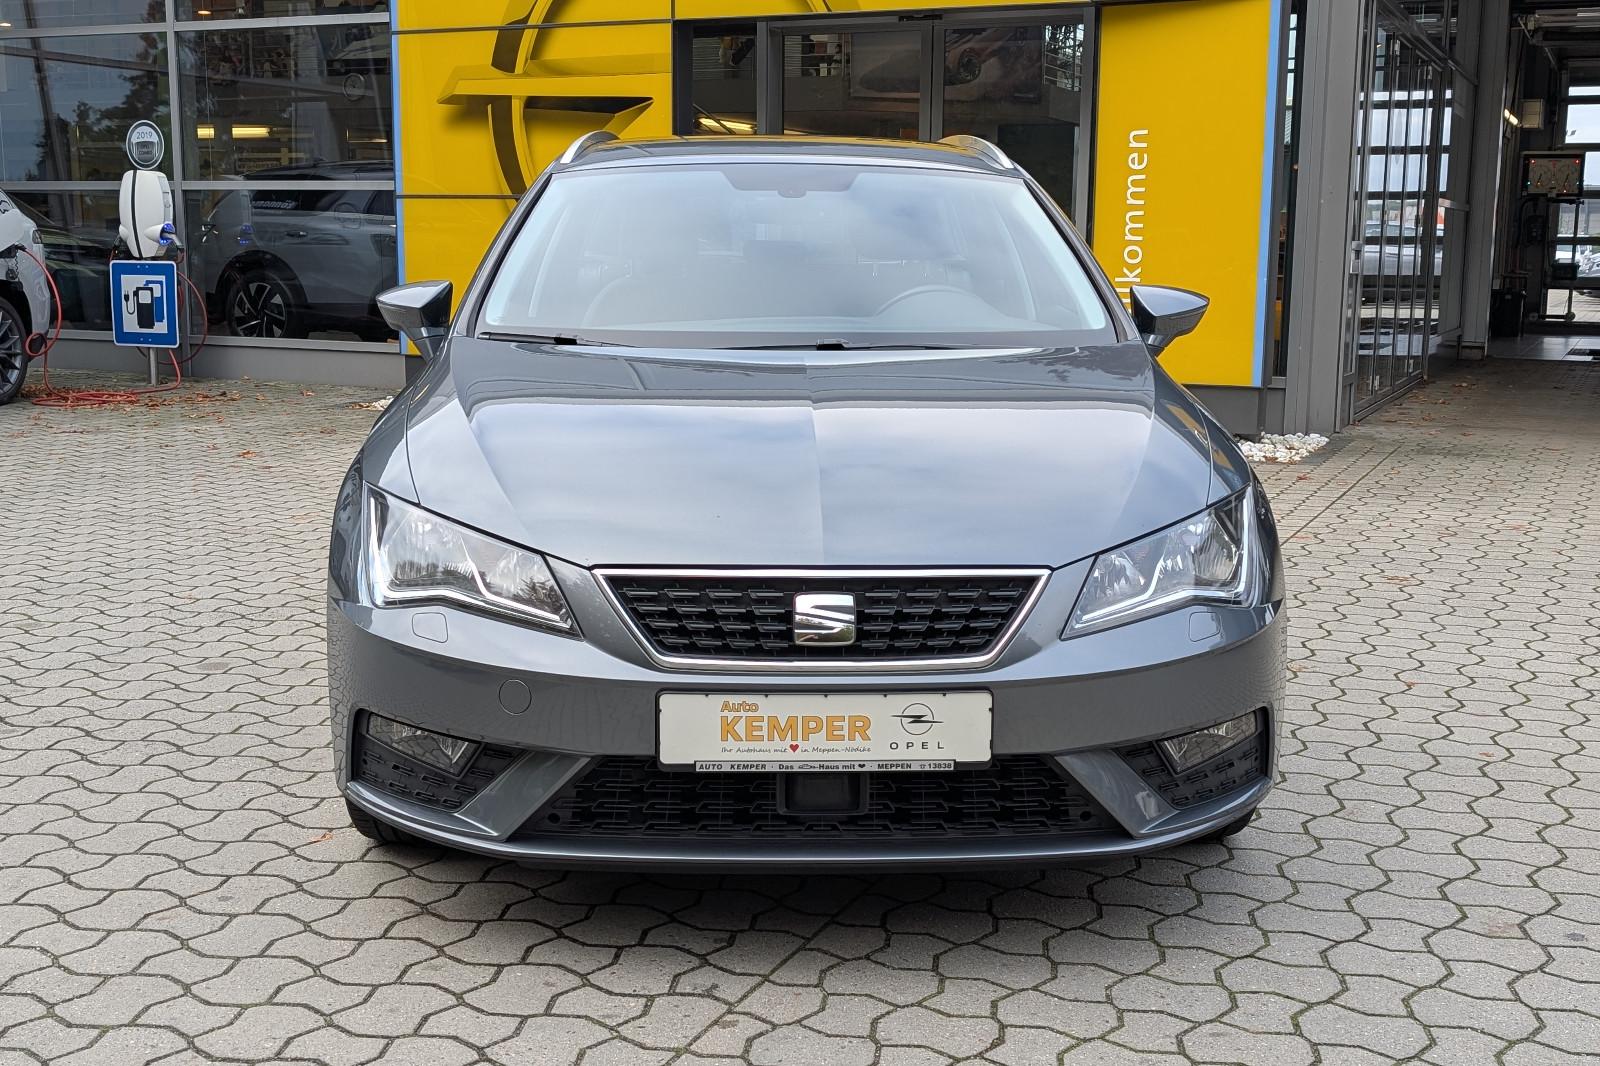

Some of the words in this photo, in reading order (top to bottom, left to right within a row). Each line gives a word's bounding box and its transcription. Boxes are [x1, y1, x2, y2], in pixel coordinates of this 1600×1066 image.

[136, 131, 153, 140] 2019
[1114, 128, 1149, 316] lkommen
[720, 700, 760, 712] Auto
[720, 715, 872, 742] KEMPER
[889, 741, 945, 750] OPEL
[877, 762, 912, 770] MEPPEN
